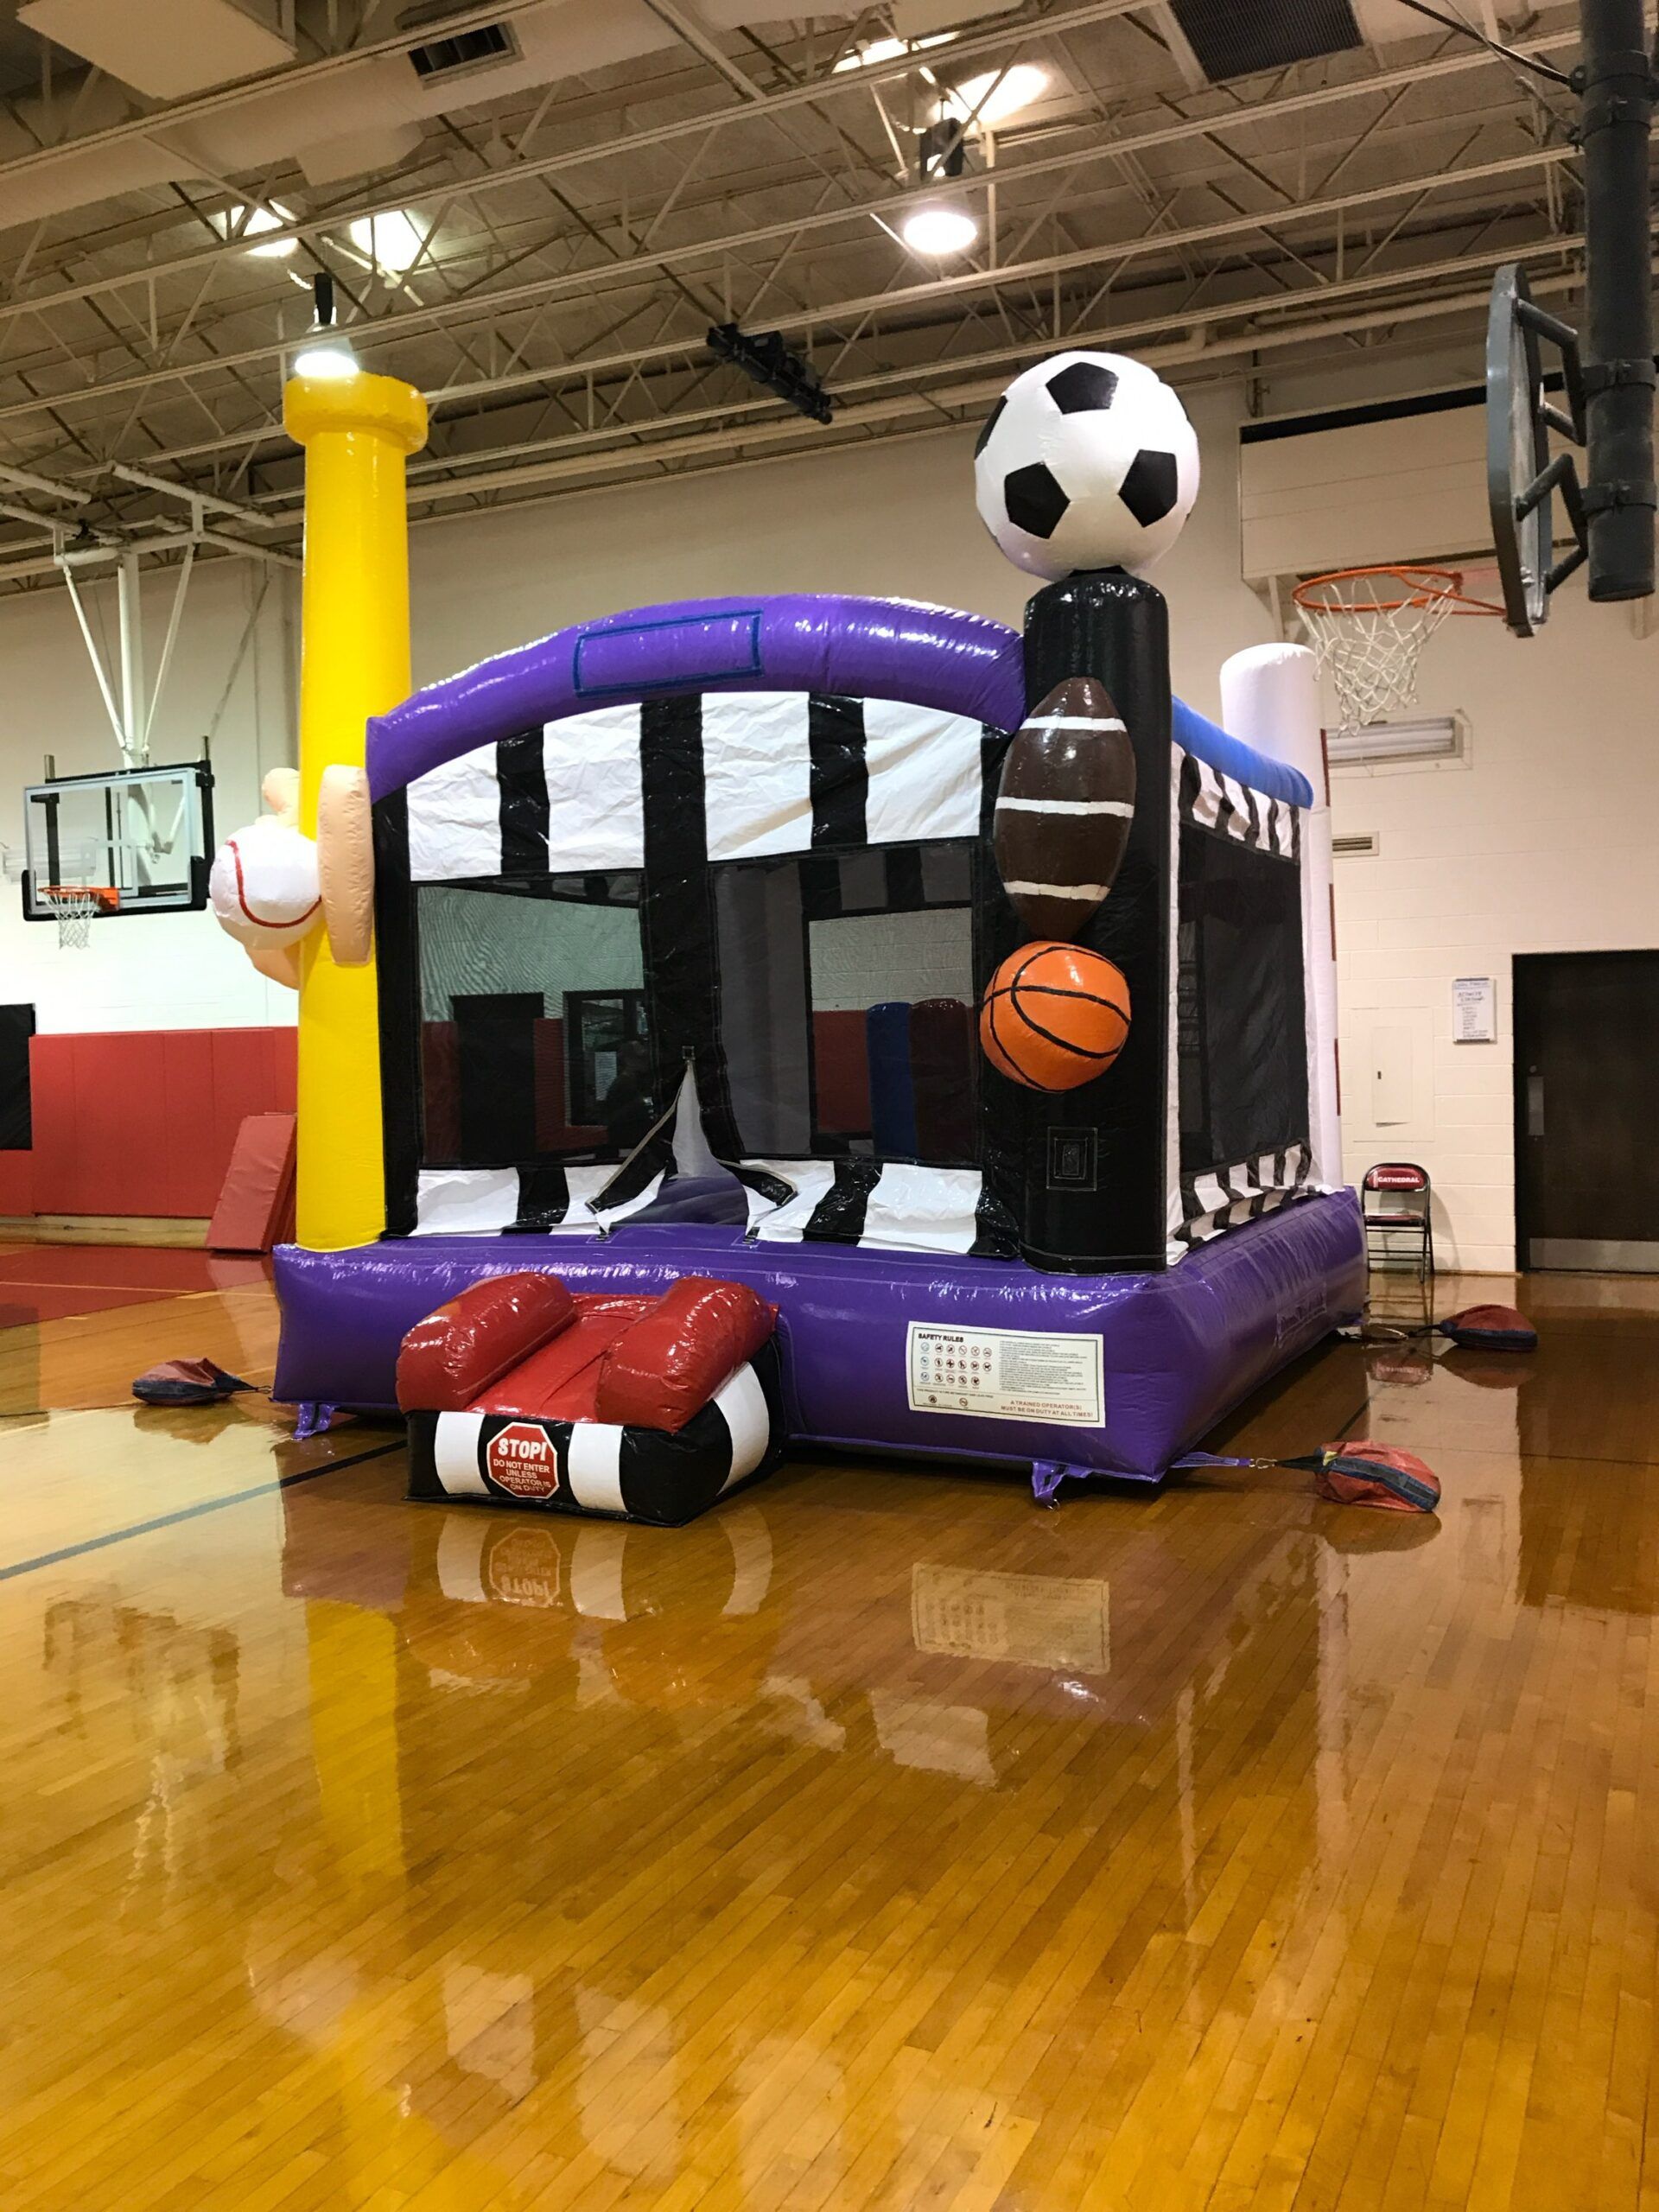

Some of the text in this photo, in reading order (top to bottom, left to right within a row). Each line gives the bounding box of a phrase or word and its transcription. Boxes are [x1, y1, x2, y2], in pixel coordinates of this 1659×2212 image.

[498, 1438, 548, 1461] STOP!
[493, 1459, 550, 1473] DO NOT ENTER
[506, 1470, 537, 1479] UNLESS
[499, 1476, 543, 1486] OPERATOR
